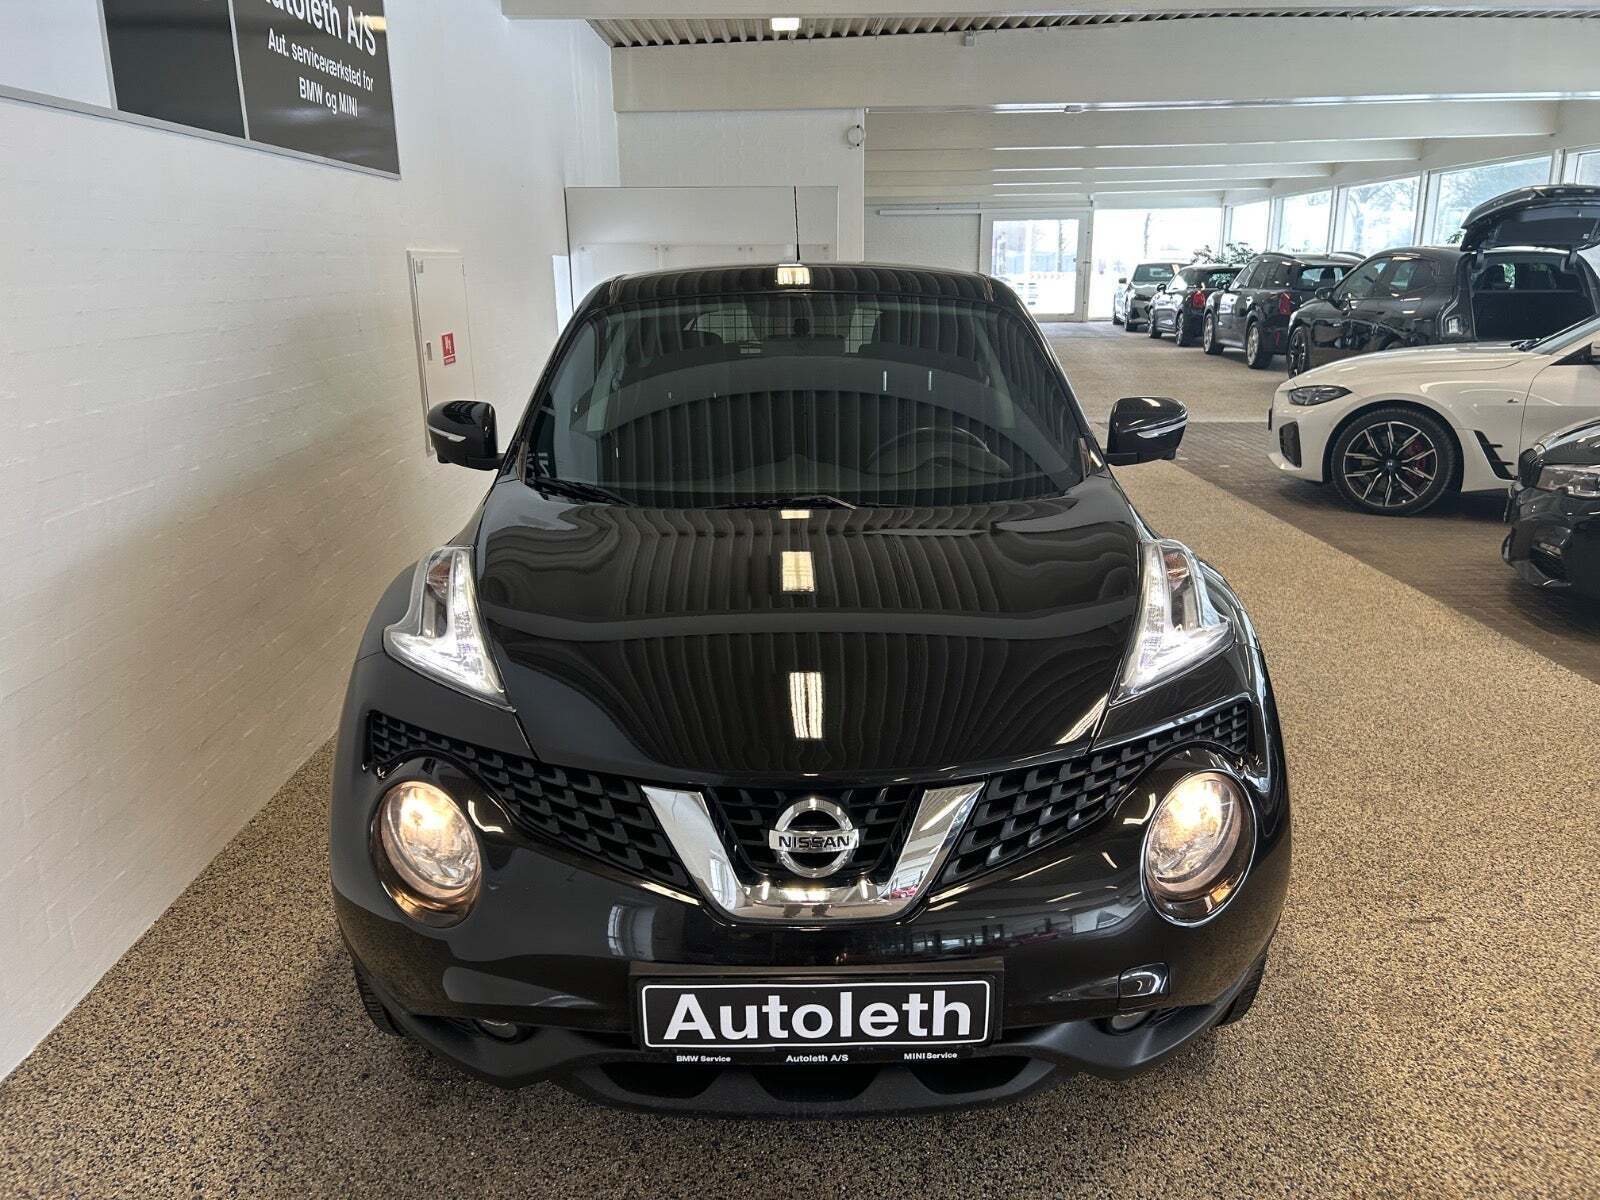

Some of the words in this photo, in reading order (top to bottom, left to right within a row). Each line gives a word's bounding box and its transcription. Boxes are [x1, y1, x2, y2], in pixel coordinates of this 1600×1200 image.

[347, 5, 376, 56] A/S
[268, 27, 289, 57] Aut.
[291, 42, 361, 87] serviceværksted
[363, 70, 374, 92] for
[299, 76, 323, 105] BMW
[325, 91, 337, 115] og
[338, 91, 358, 118] MINI
[779, 836, 849, 848] NISSAN
[663, 990, 971, 1040] Autoleth
[786, 1054, 828, 1062] Autoleth
[830, 1054, 849, 1062] A/S
[903, 1052, 926, 1060] MINI
[926, 1051, 958, 1059] Service
